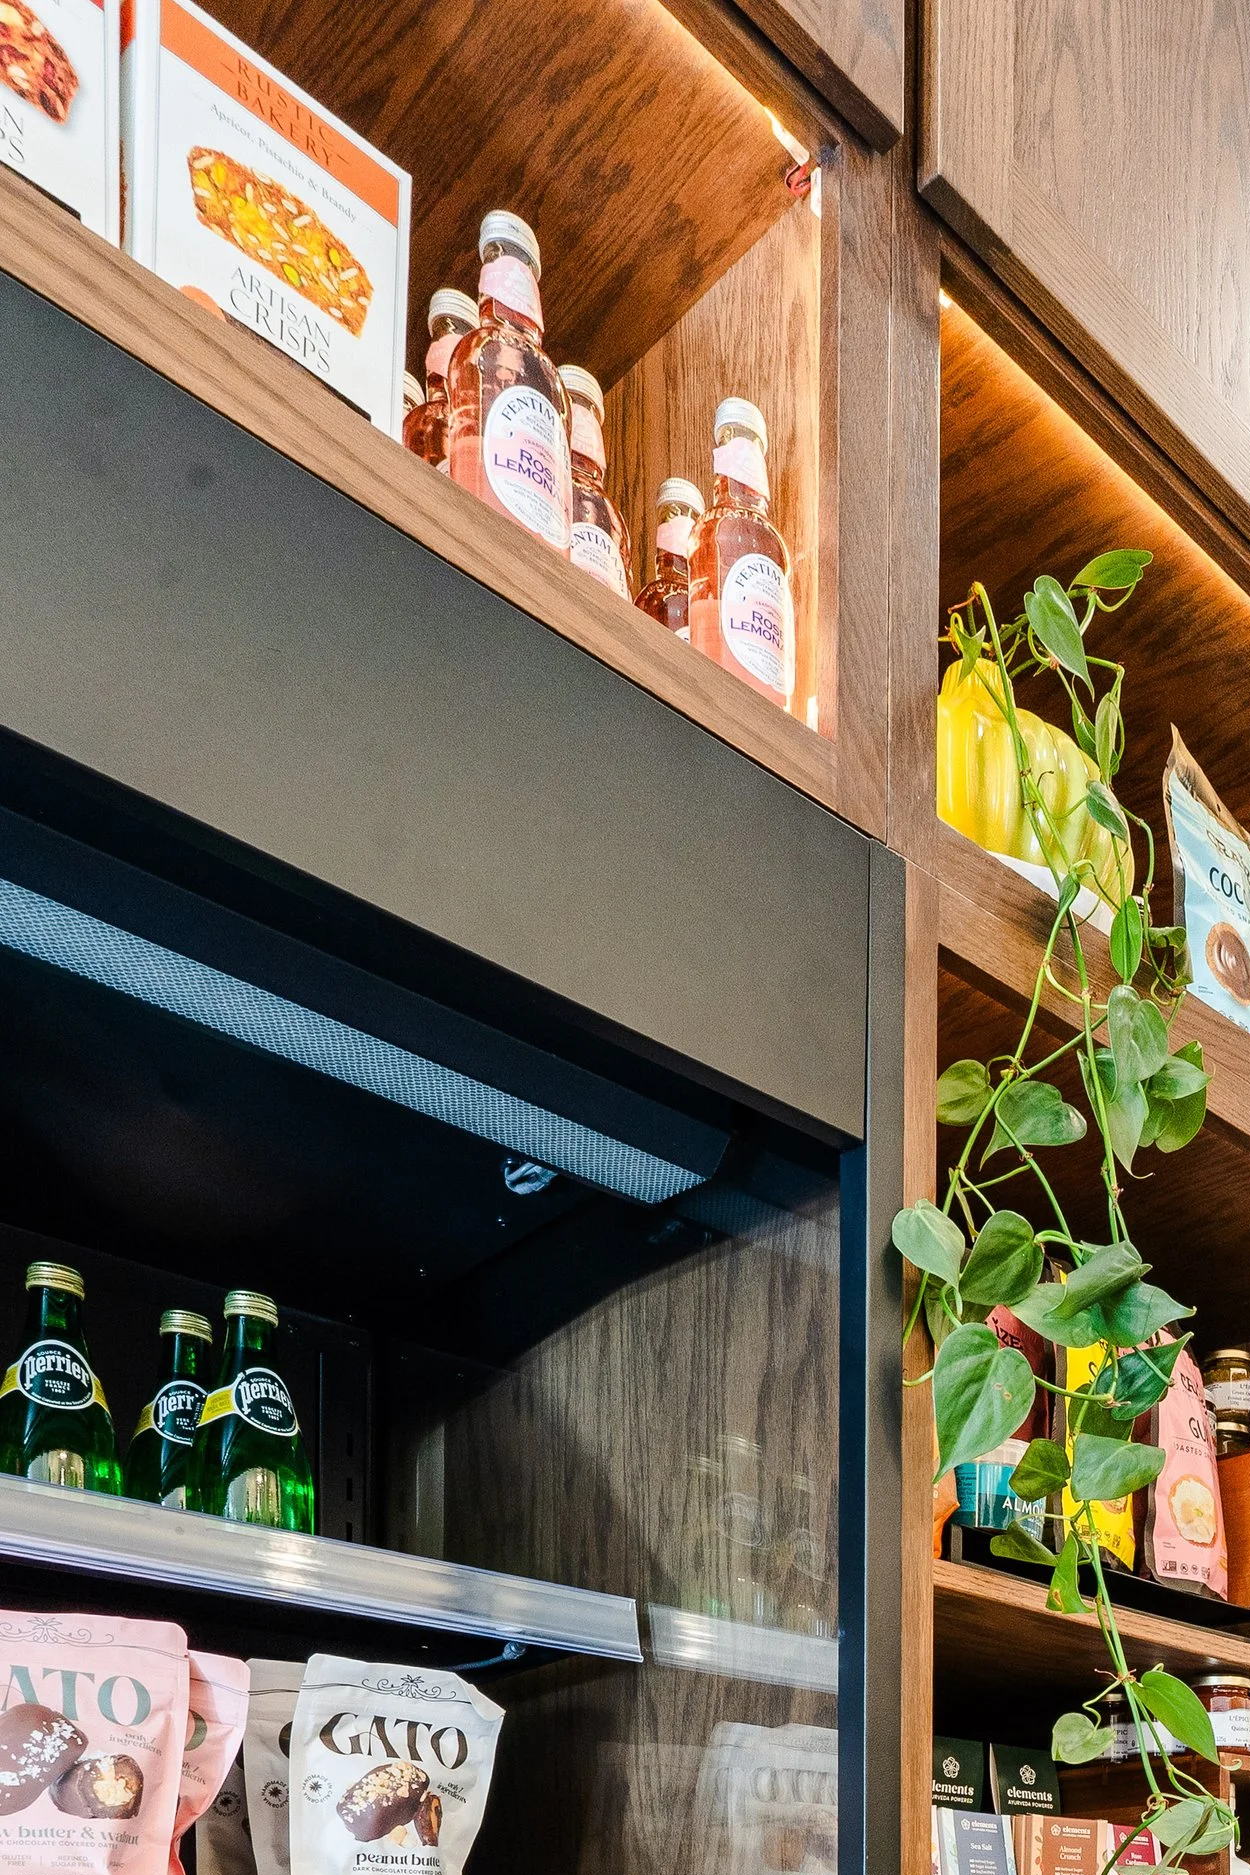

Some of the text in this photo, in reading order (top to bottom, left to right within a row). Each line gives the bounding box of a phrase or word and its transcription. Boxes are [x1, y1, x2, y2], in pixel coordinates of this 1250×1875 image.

[236, 58, 338, 147] RUSTIC
[235, 81, 334, 168] BAKERY
[209, 103, 256, 145] Apricot,
[257, 136, 306, 183] Pistachio
[321, 187, 358, 224] Brandy
[230, 266, 332, 349] ARTISAN
[229, 287, 332, 375] CRISPS
[36, 1348, 62, 1357] SOURCE
[24, 1353, 89, 1391] perrier
[239, 1379, 293, 1417] perrier
[319, 1711, 469, 1771] GATO
[1006, 1786, 1053, 1803] elements
[1007, 1799, 1054, 1811] AYURVEDA POWERED
[18, 1825, 77, 1840] butter
[81, 1825, 95, 1841] &
[971, 1821, 998, 1831] elements
[1062, 1825, 1091, 1836] elements
[970, 1842, 993, 1851] Sea Salt
[1059, 1845, 1083, 1854] Almond
[356, 1852, 409, 1867] peanut
[1059, 1852, 1082, 1861] Crunch
[371, 1867, 408, 1875] CHOCOLATE
